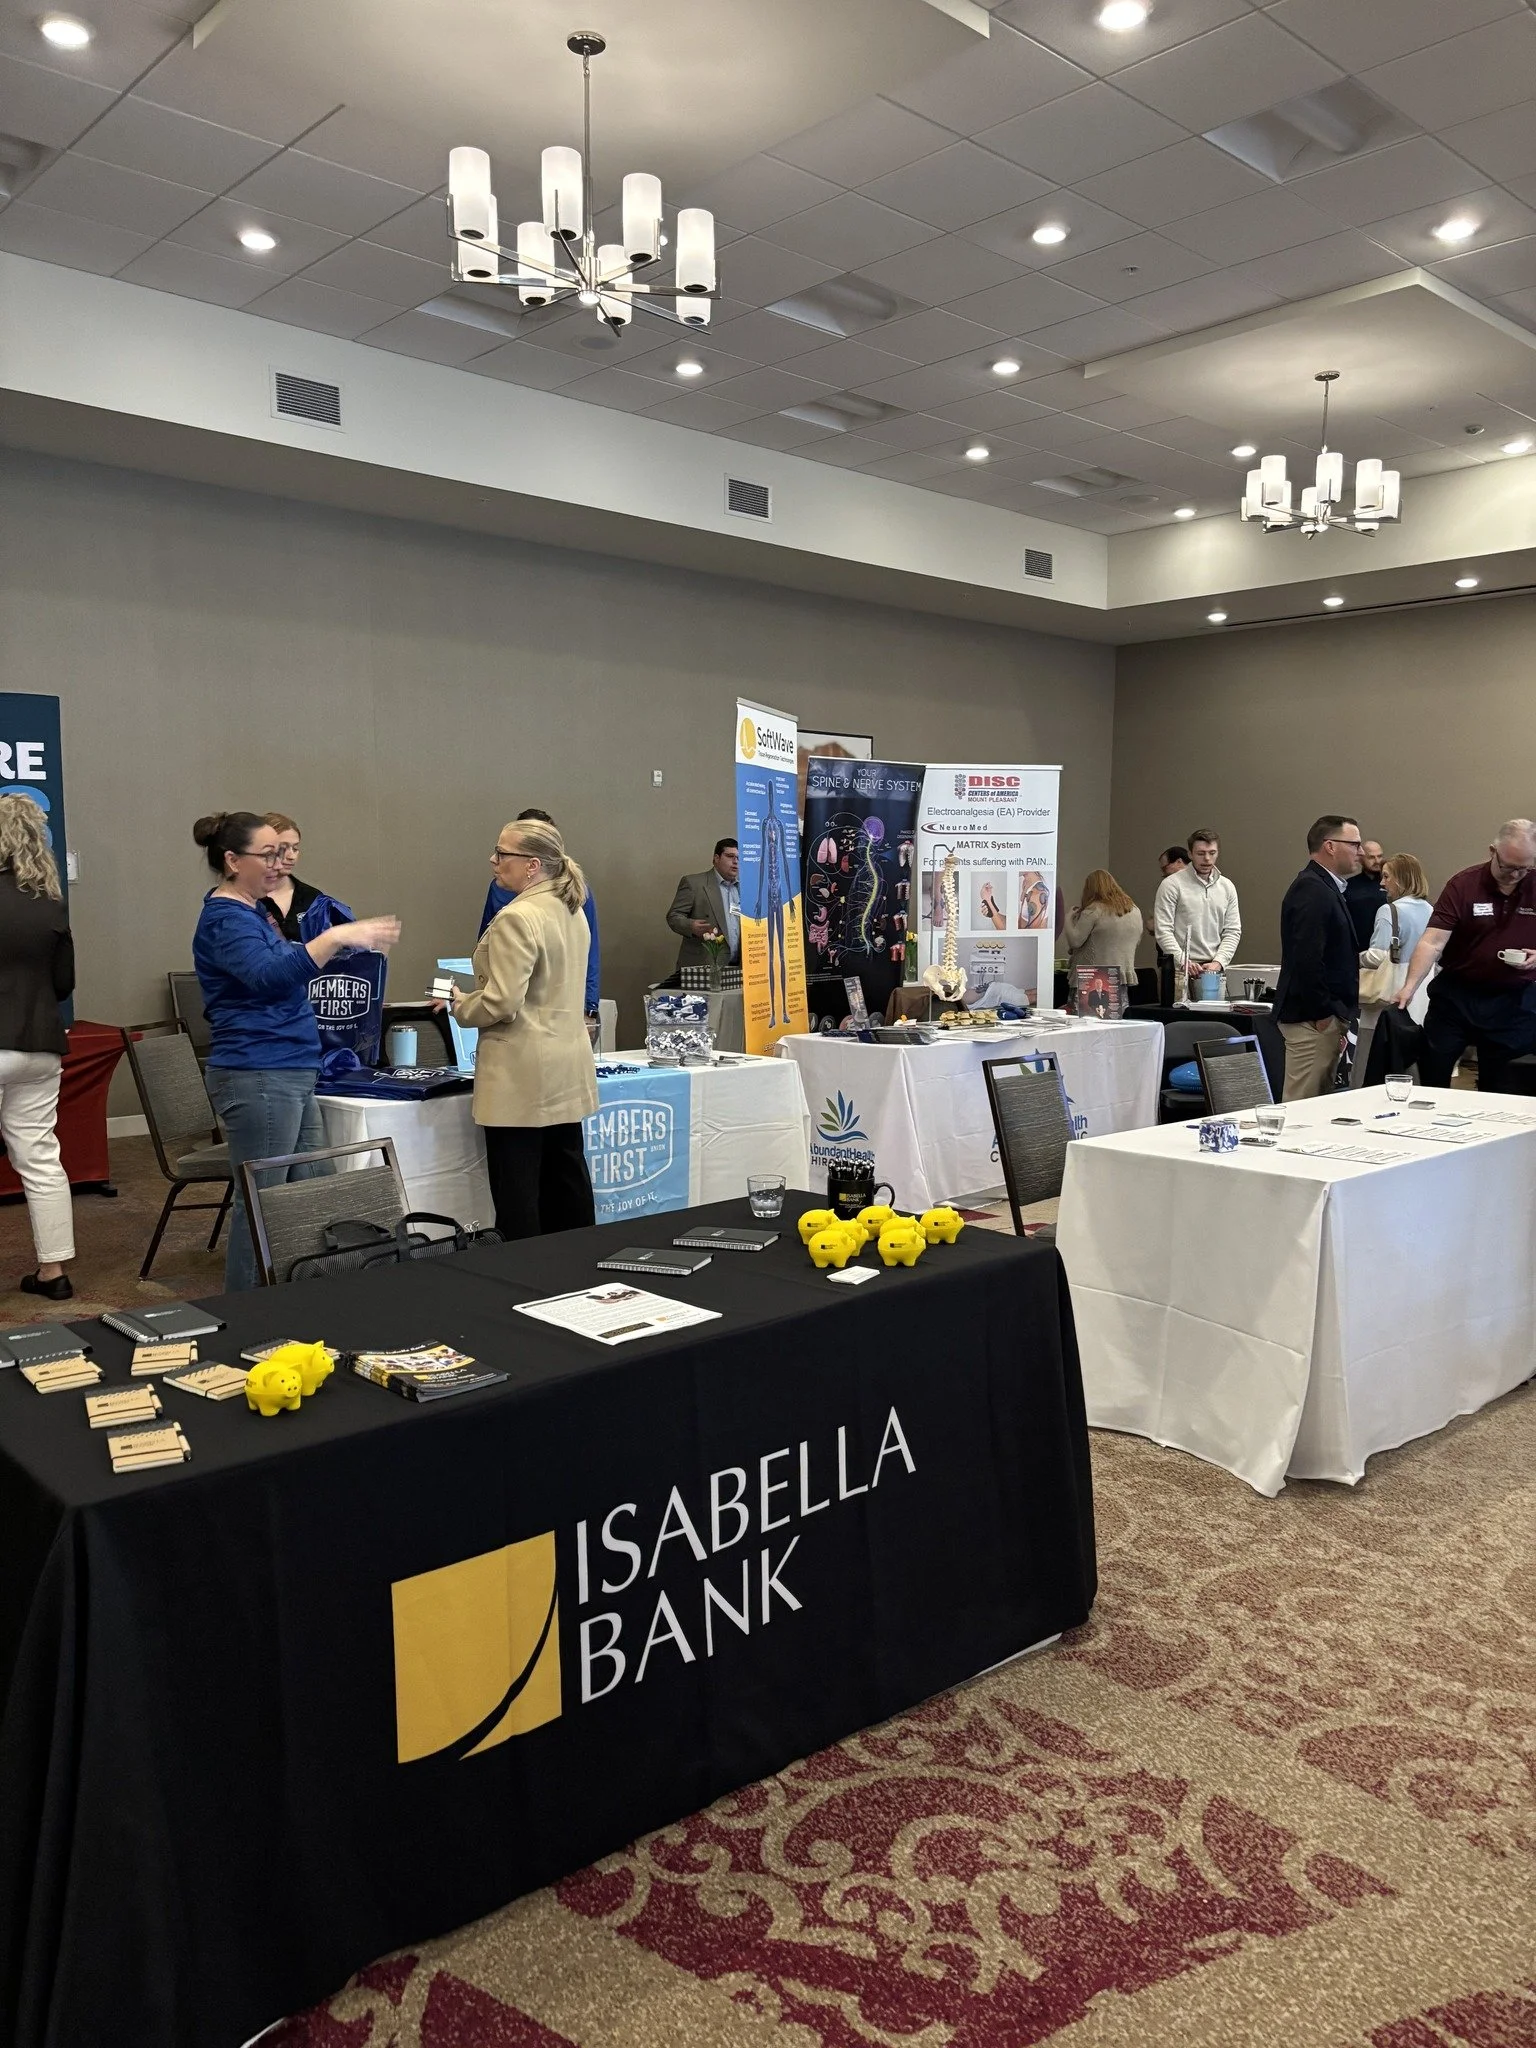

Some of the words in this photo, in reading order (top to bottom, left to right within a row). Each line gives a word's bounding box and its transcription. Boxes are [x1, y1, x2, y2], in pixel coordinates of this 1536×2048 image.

[757, 727, 794, 754] SoftWave
[857, 768, 877, 777] YOUR
[812, 775, 841, 788] SPINE
[843, 777, 850, 789] &
[853, 778, 885, 791] NERVE
[886, 779, 922, 792] SYSTEM
[968, 776, 1021, 788] DISC
[927, 807, 995, 818] Electroanalgesia
[996, 807, 1016, 818] (EA)
[1016, 808, 1051, 817] Provider
[956, 841, 989, 849] MATRIX
[991, 841, 1021, 850] System
[923, 858, 938, 866] For
[973, 857, 1007, 868] suffering
[1008, 858, 1024, 866] with
[311, 979, 367, 999] MEMBERS
[320, 1000, 354, 1016] FIRST
[585, 1109, 666, 1151] EMBERS
[591, 1147, 648, 1184] FIRST
[600, 1203, 614, 1213] THE
[618, 1200, 633, 1212] JOY
[635, 1196, 646, 1207] OF
[577, 1406, 916, 1605] ISABELLA
[580, 1535, 803, 1704] BANK
